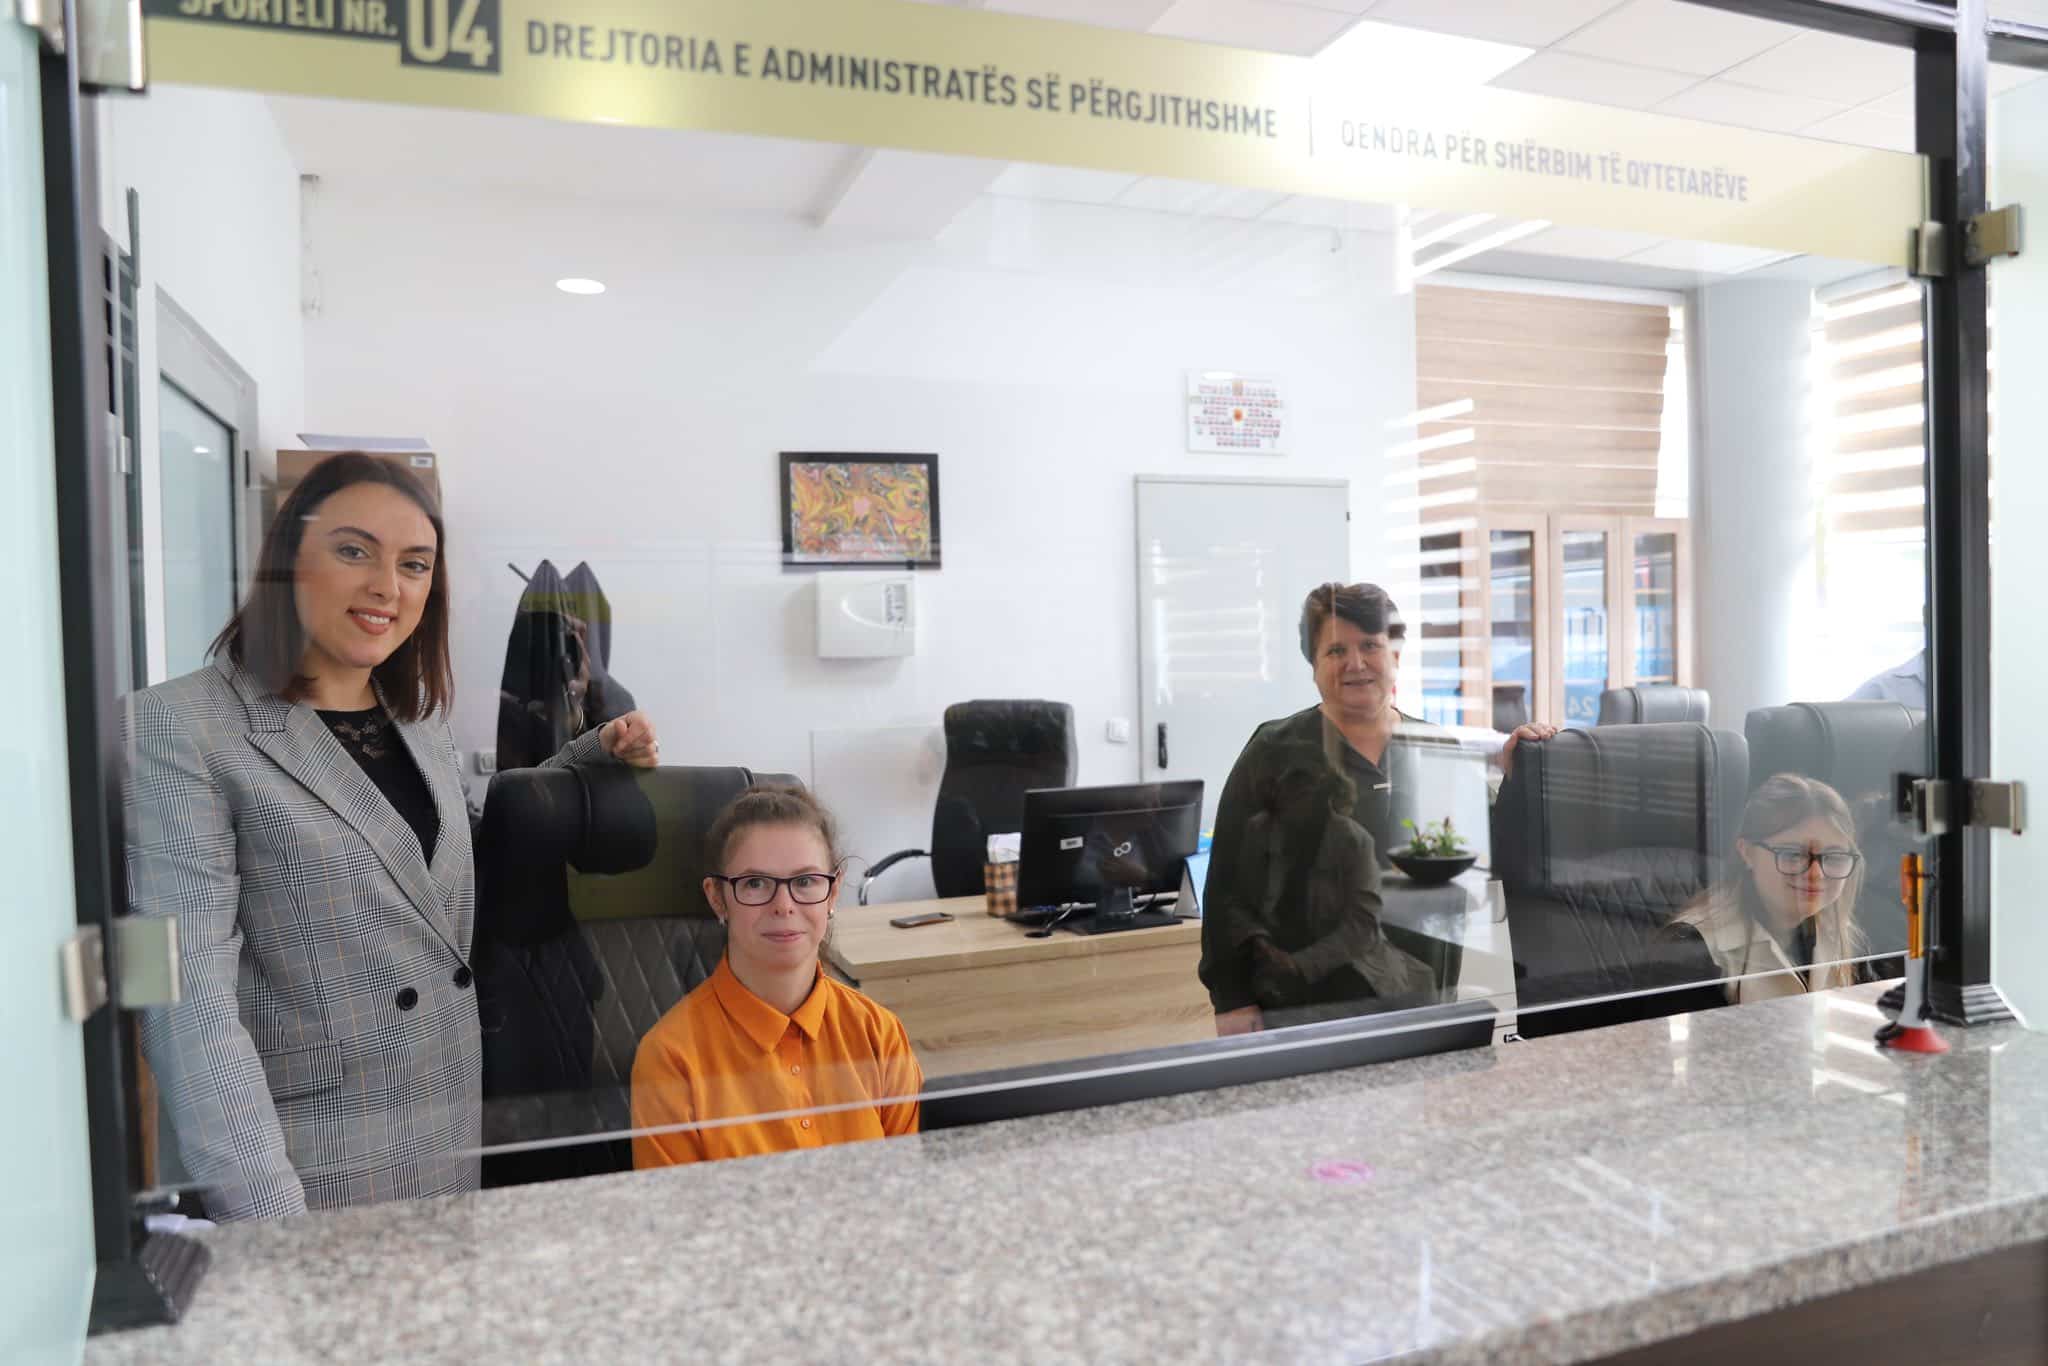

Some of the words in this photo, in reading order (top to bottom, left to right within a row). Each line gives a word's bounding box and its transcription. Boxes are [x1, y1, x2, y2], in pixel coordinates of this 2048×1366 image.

[342, 0, 399, 36] NR.
[526, 19, 723, 74] DREJTORIA
[735, 43, 752, 76] E
[761, 46, 1017, 107] ADMINISTRATËS
[1026, 72, 1061, 112] SË
[1069, 79, 1278, 138] PËRGJITHSHME
[1341, 118, 1438, 160] QENDRA
[1444, 129, 1488, 167] PËR
[1494, 137, 1592, 181] SHËRBIM
[1597, 148, 1622, 186] TË
[1625, 157, 1749, 203] QYTETARËVE
